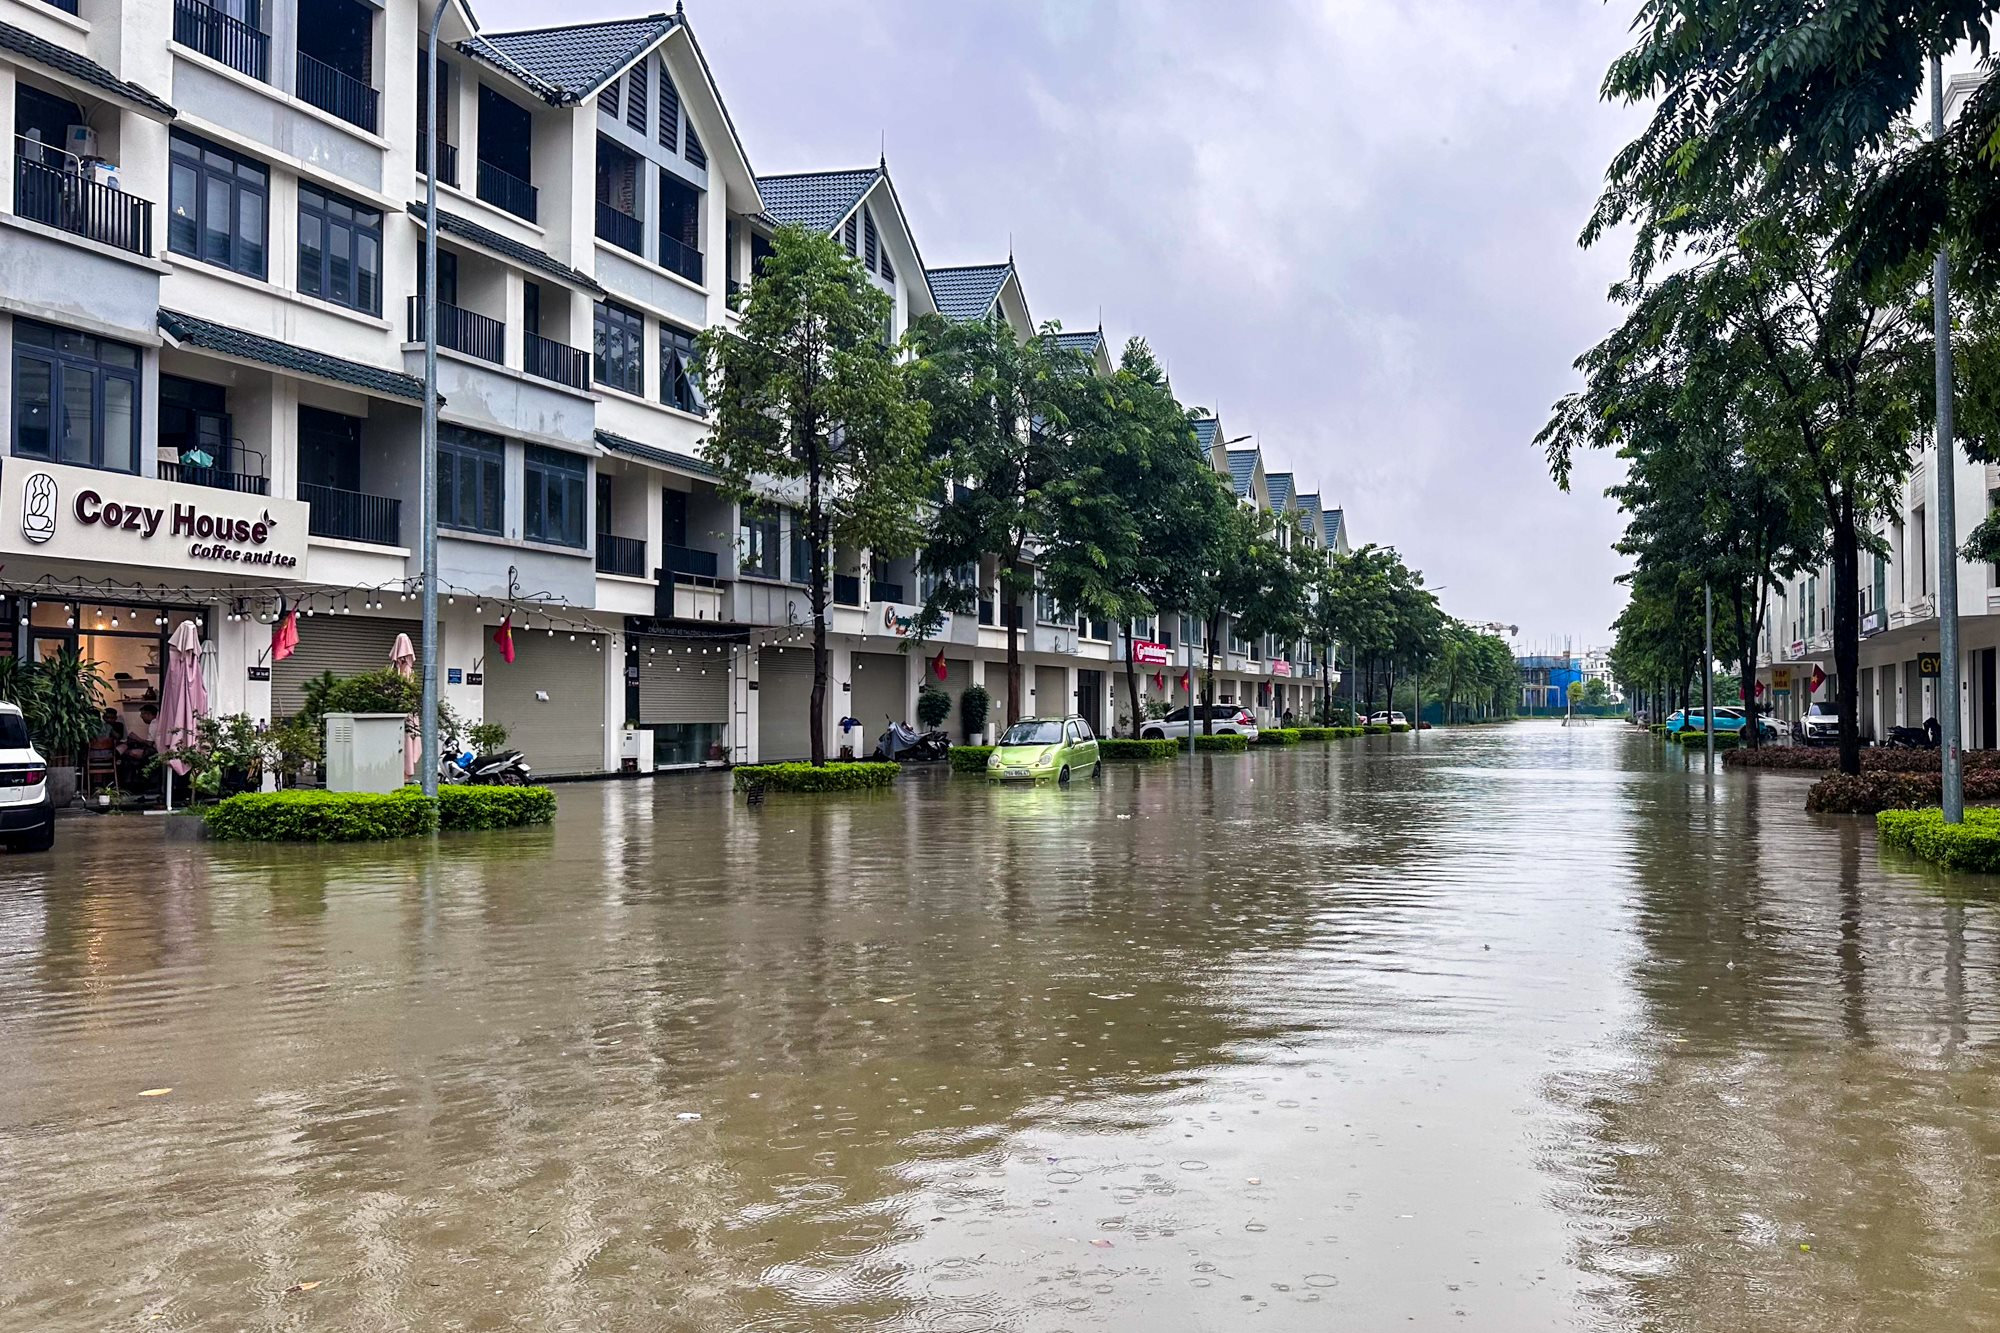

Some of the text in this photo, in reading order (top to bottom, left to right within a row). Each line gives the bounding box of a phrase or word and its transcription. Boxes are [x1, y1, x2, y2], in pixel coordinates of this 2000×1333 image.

[75, 489, 268, 545] Cozy House
[190, 543, 297, 567] Coffee and tea
[1921, 657, 1941, 673] GY
